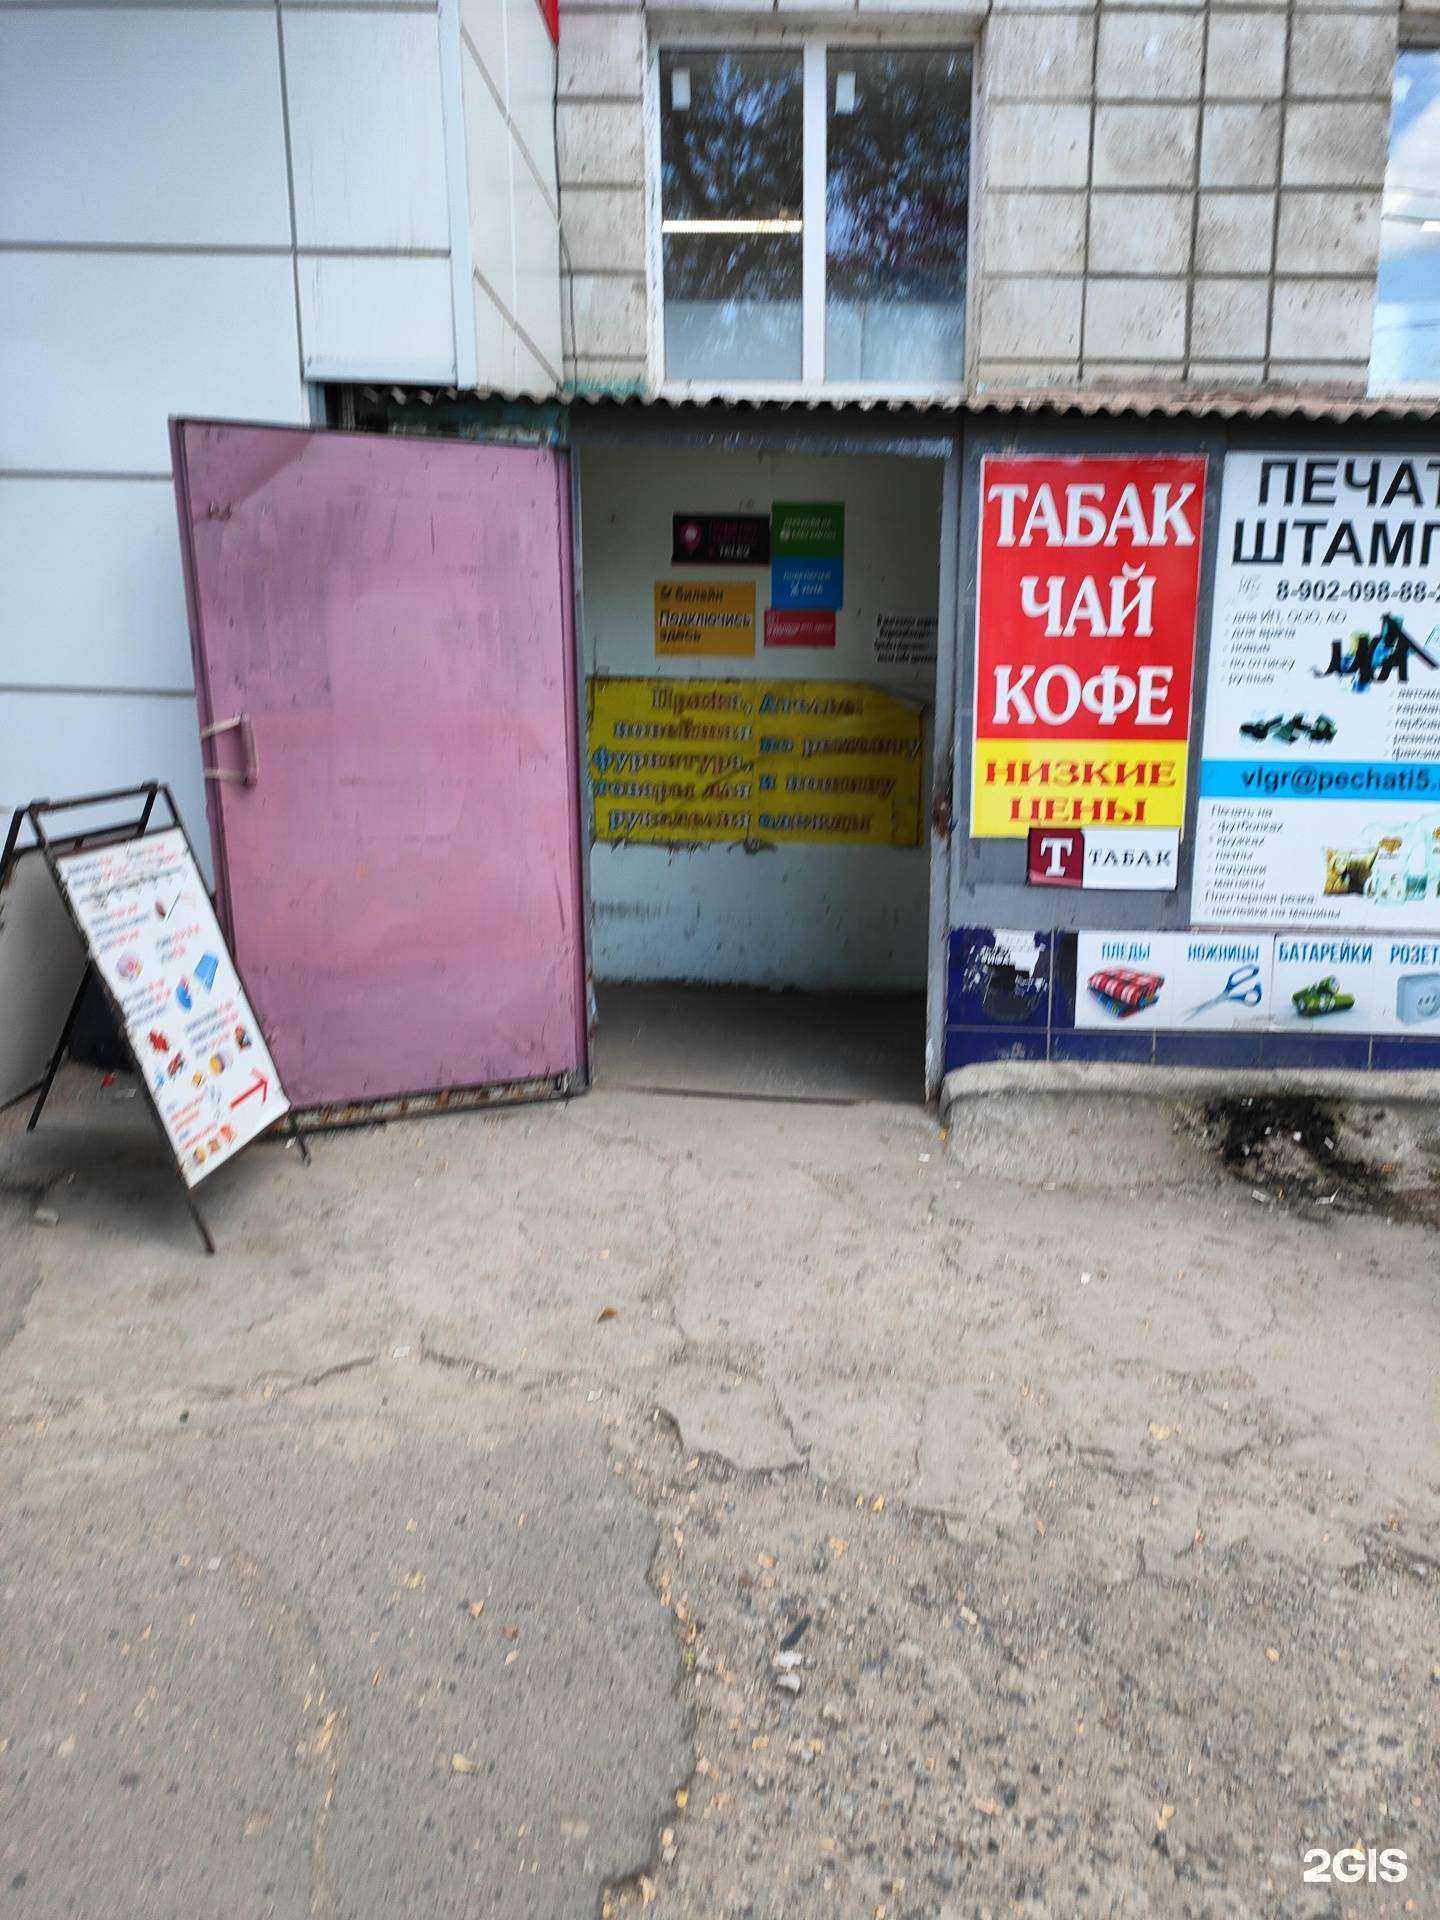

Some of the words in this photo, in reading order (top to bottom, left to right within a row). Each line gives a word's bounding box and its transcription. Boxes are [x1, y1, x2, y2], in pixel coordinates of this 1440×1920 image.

[988, 482, 1196, 548] ТАБАК
[1020, 561, 1157, 638] ЧАЙ
[1275, 578, 1440, 602] 8-902-098-88-
[992, 664, 1174, 727] КОФЕ
[985, 758, 1177, 788] НИЗКИЕ
[1241, 765, 1440, 795] vlgr@pechati5.
[1009, 795, 1150, 826] ЦЕНЫ
[1040, 836, 1074, 877] Т
[1088, 848, 1172, 868] ТАБАК
[1187, 942, 1261, 963] НОЖНИЦЫ
[1279, 937, 1373, 964] БАТАРЕЙКИ
